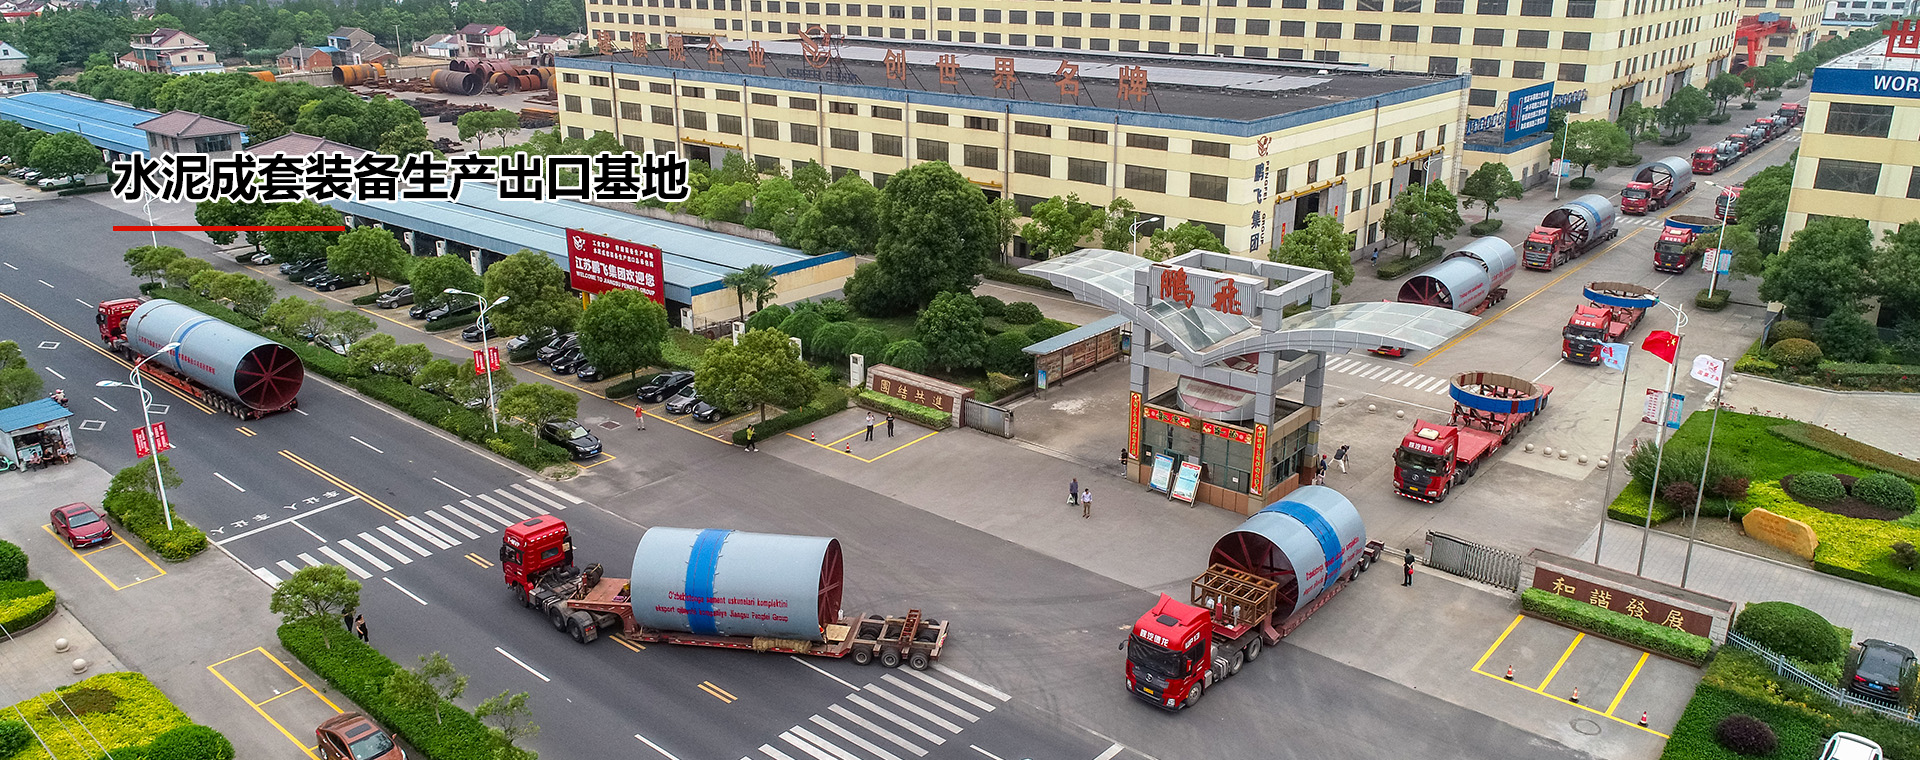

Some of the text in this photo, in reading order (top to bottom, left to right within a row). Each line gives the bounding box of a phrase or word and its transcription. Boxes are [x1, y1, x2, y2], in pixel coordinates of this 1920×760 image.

[883, 49, 1149, 101] 创世界名牌
[1873, 75, 1920, 92] WOR
[574, 255, 656, 288] 江苏鹏飞集团欢迎您
